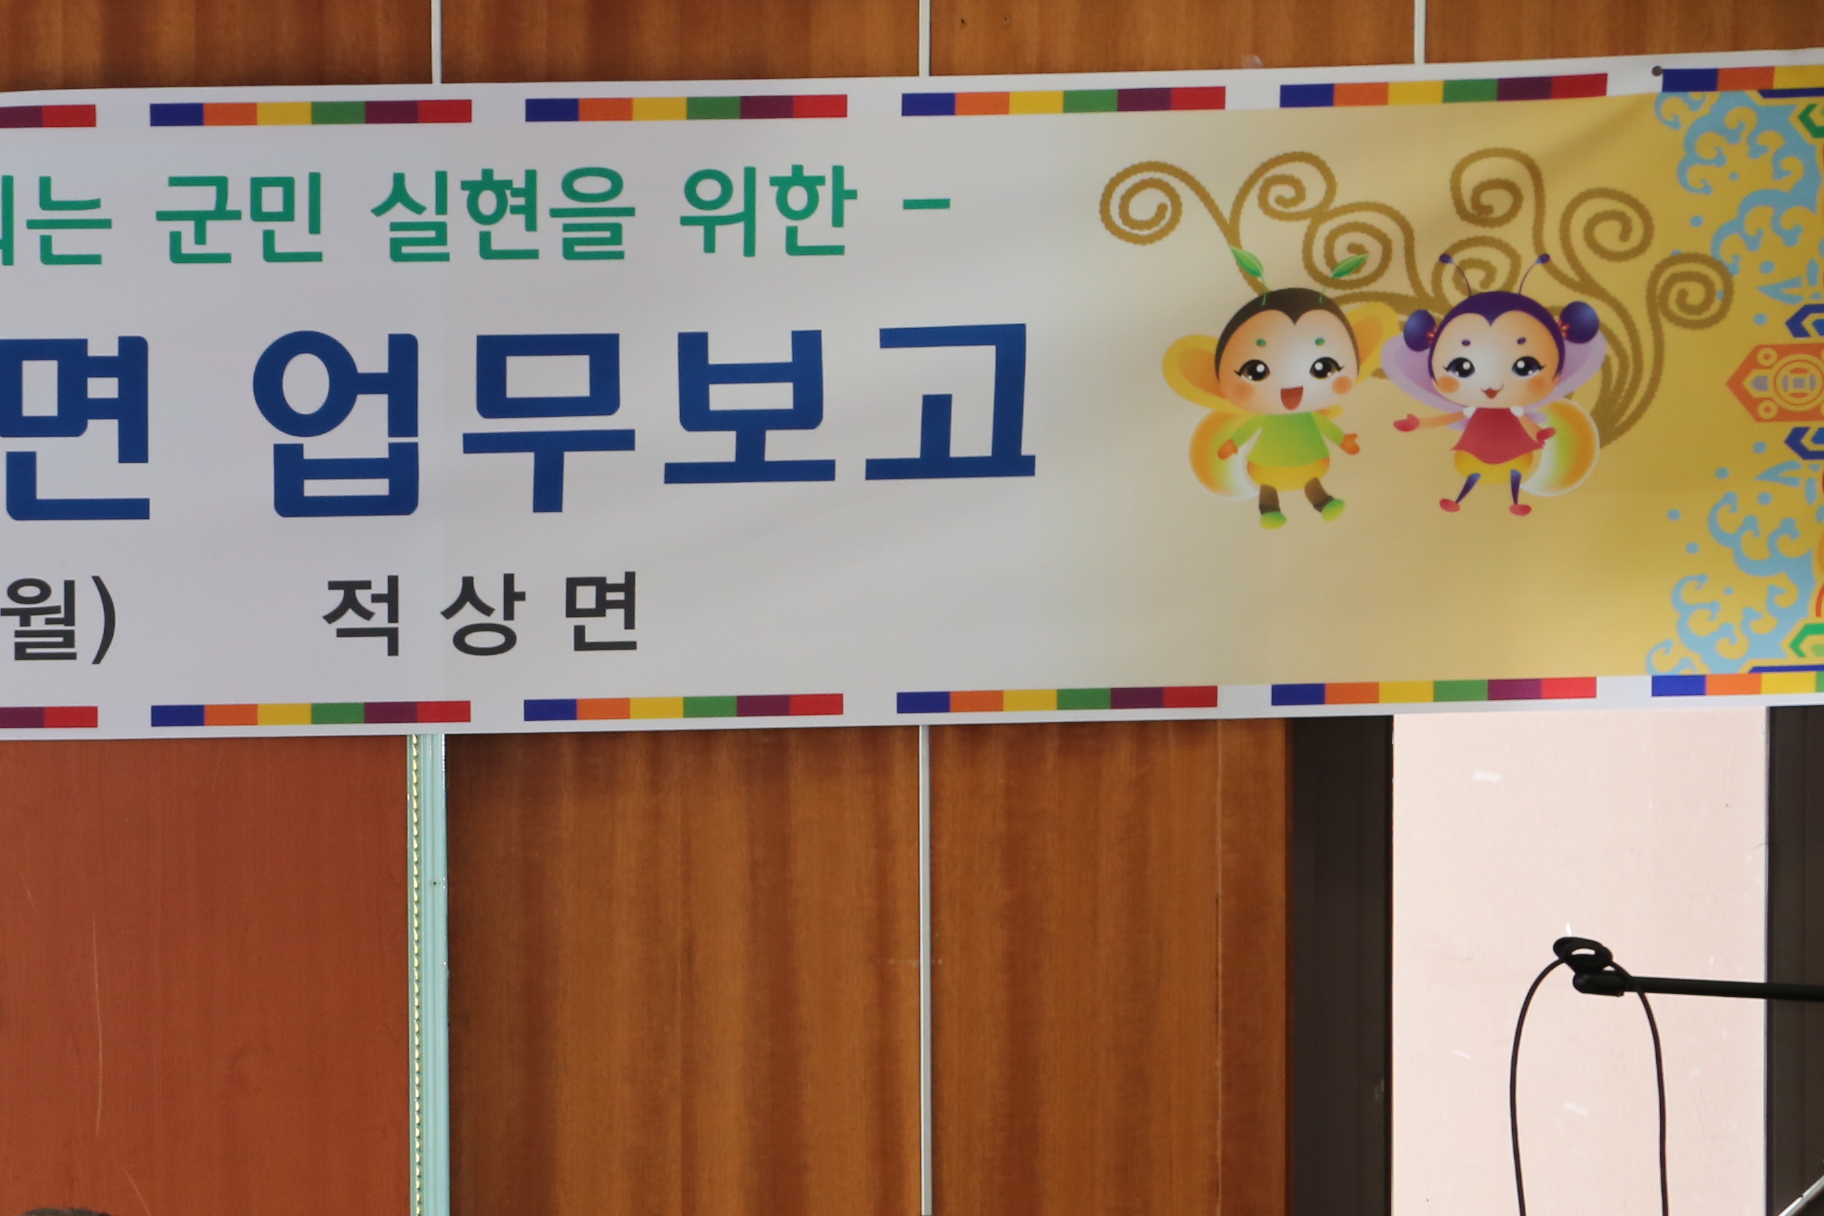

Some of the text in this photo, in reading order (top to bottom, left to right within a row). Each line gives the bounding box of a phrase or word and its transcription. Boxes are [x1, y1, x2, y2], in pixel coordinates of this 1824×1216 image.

[155, 172, 324, 264] 군민
[371, 166, 636, 263] 실현을
[679, 164, 858, 258] 위한
[253, 323, 1036, 517] 업무보고
